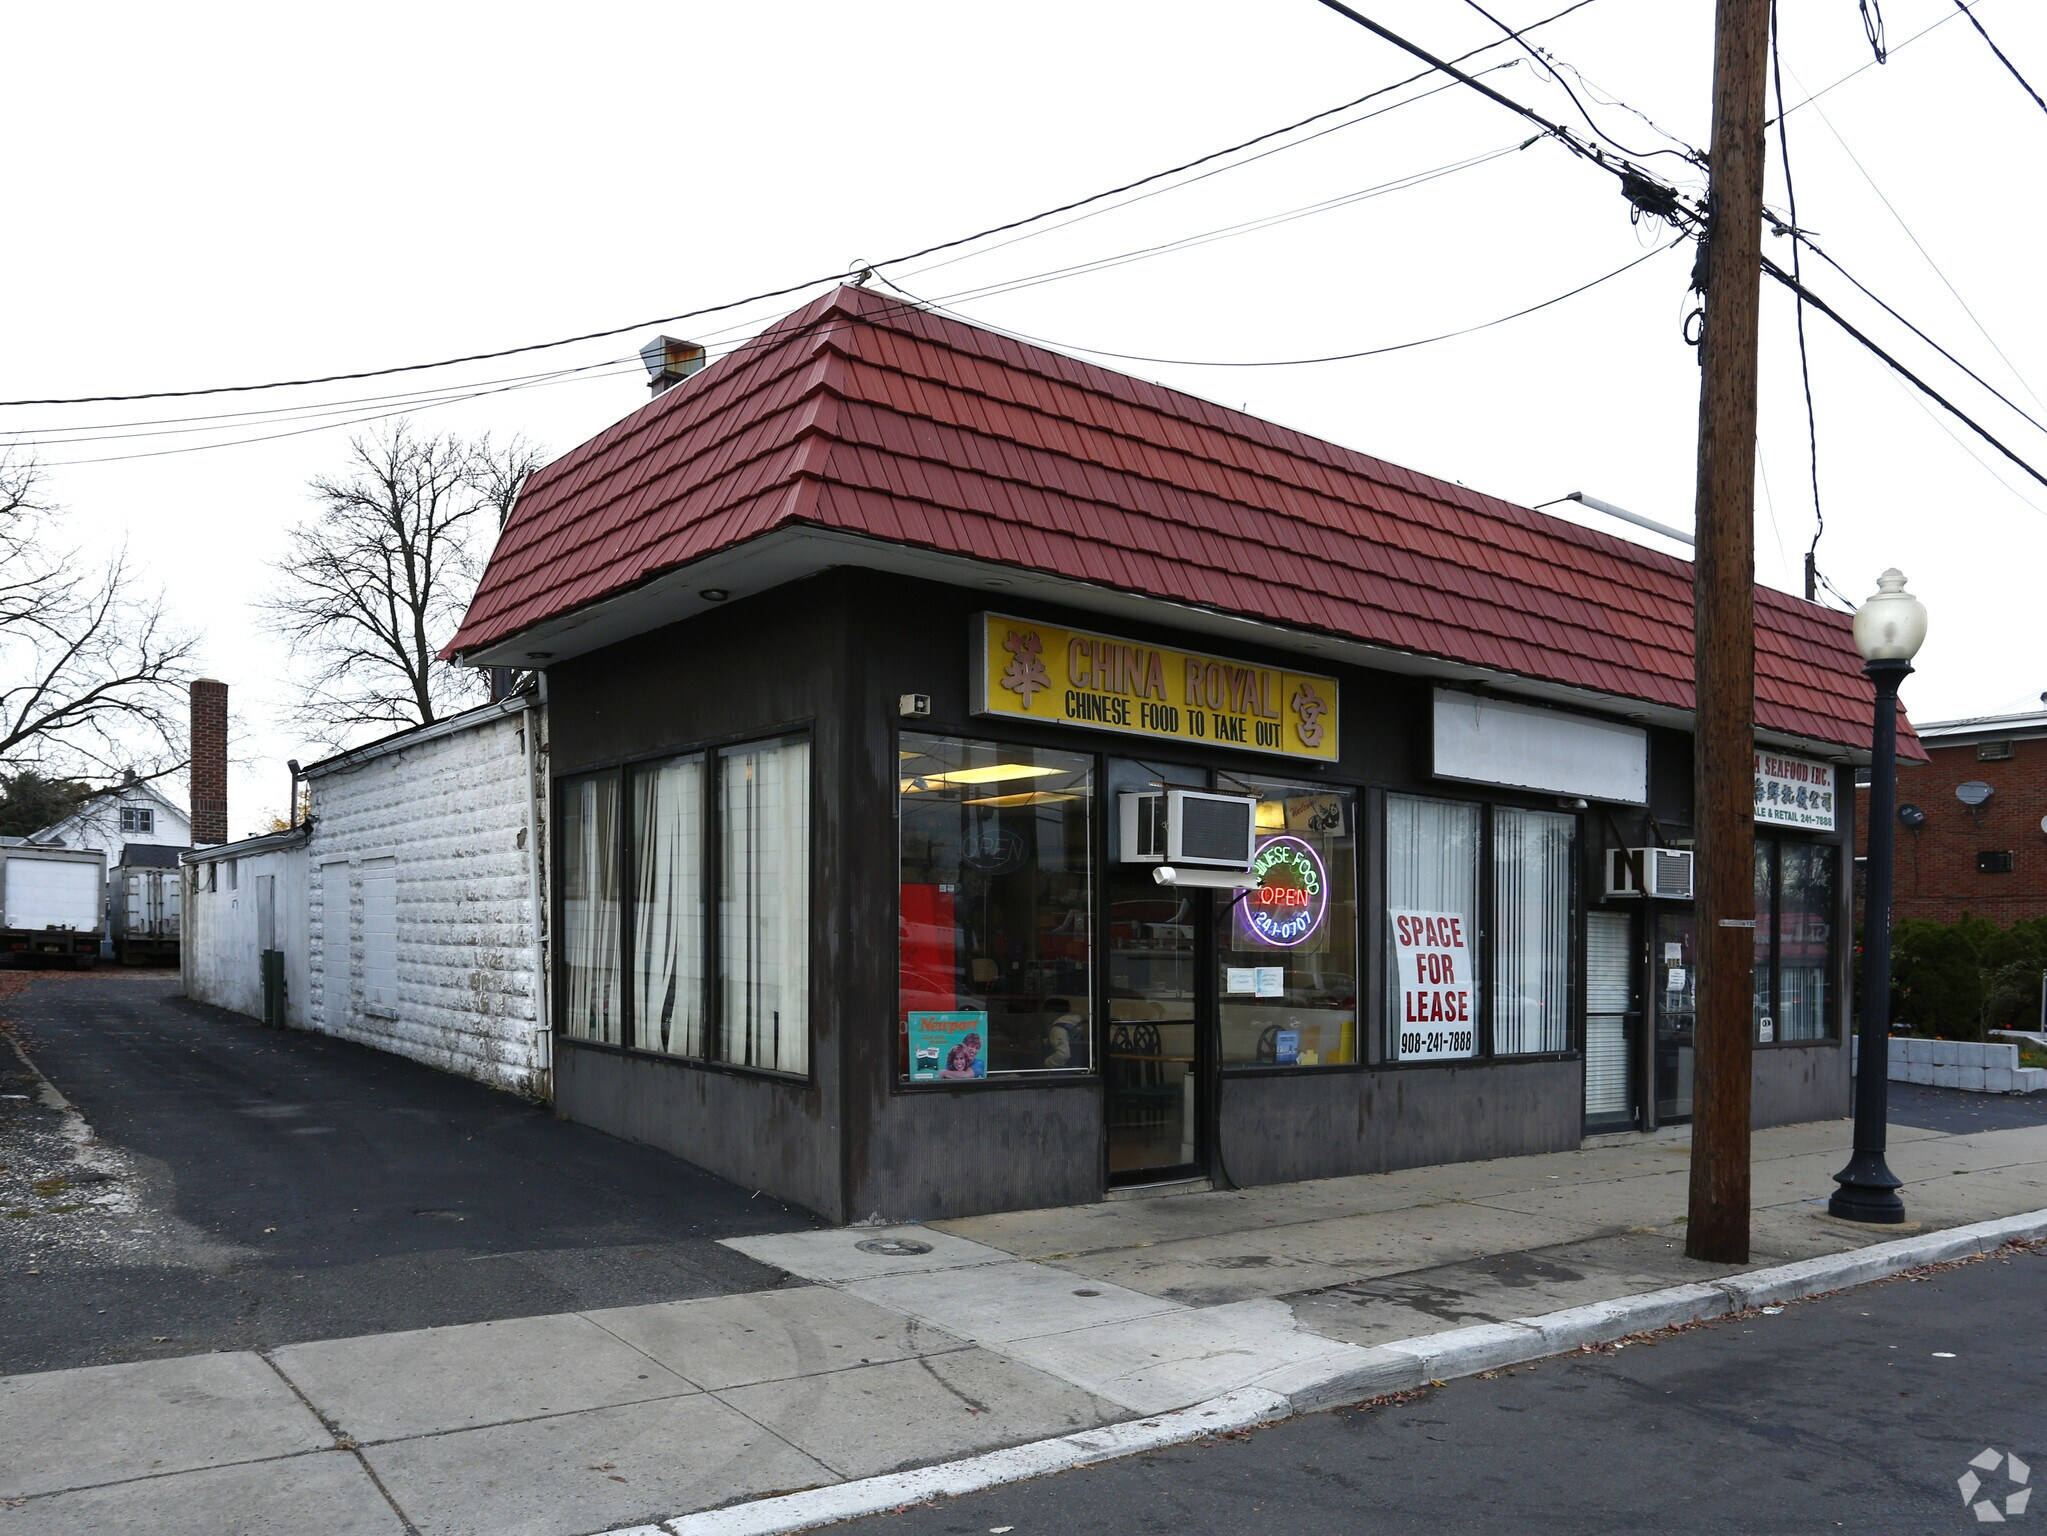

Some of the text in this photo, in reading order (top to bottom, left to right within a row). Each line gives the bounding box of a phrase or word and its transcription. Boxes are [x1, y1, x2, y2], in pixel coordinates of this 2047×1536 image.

[1068, 637, 1280, 719] CHINA ROYAL
[1065, 690, 1282, 748] CHINESE FOOD TO TAKE OUT
[1765, 756, 1808, 783] SEAFOOD
[1811, 766, 1831, 787] INC.
[1775, 810, 1798, 822] RETAIL
[1292, 851, 1320, 896] FOOD
[1261, 886, 1309, 907] OPEN
[1255, 911, 1311, 939] 241-0707
[1397, 914, 1464, 948] SPACE
[1416, 953, 1455, 985] FOR
[1406, 991, 1469, 1023] LEASE
[919, 1016, 979, 1034] Newport
[1401, 1031, 1472, 1053] 908-241-7888
